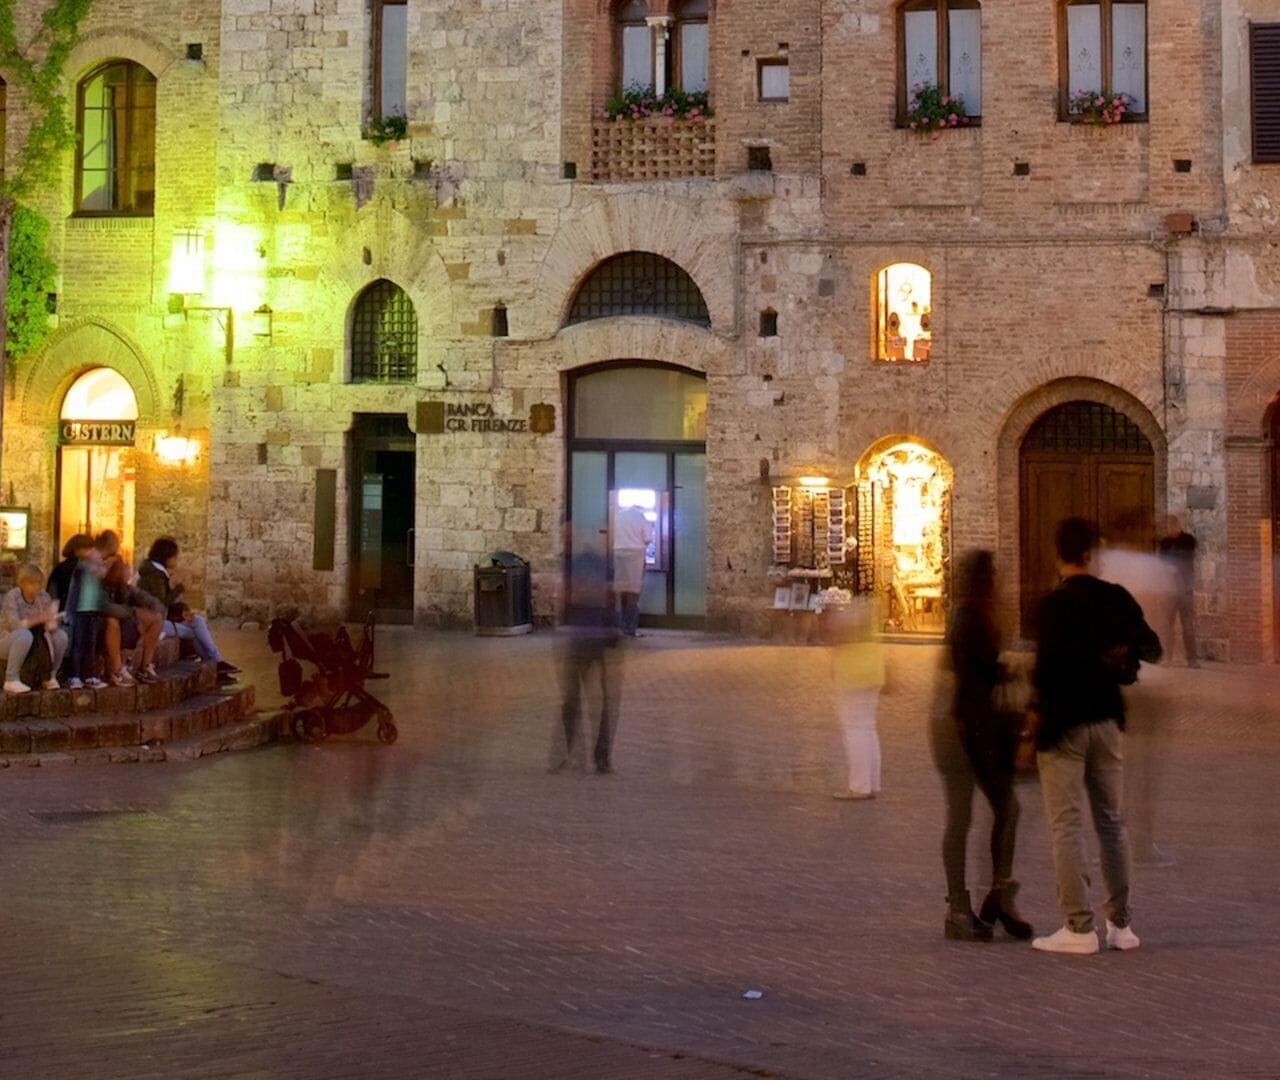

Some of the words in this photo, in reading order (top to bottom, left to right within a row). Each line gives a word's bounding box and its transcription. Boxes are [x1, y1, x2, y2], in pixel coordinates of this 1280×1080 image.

[447, 404, 495, 417] BANCA
[63, 423, 135, 440] CISTERN
[447, 419, 468, 432] CR
[472, 419, 528, 432] FIRENZE
